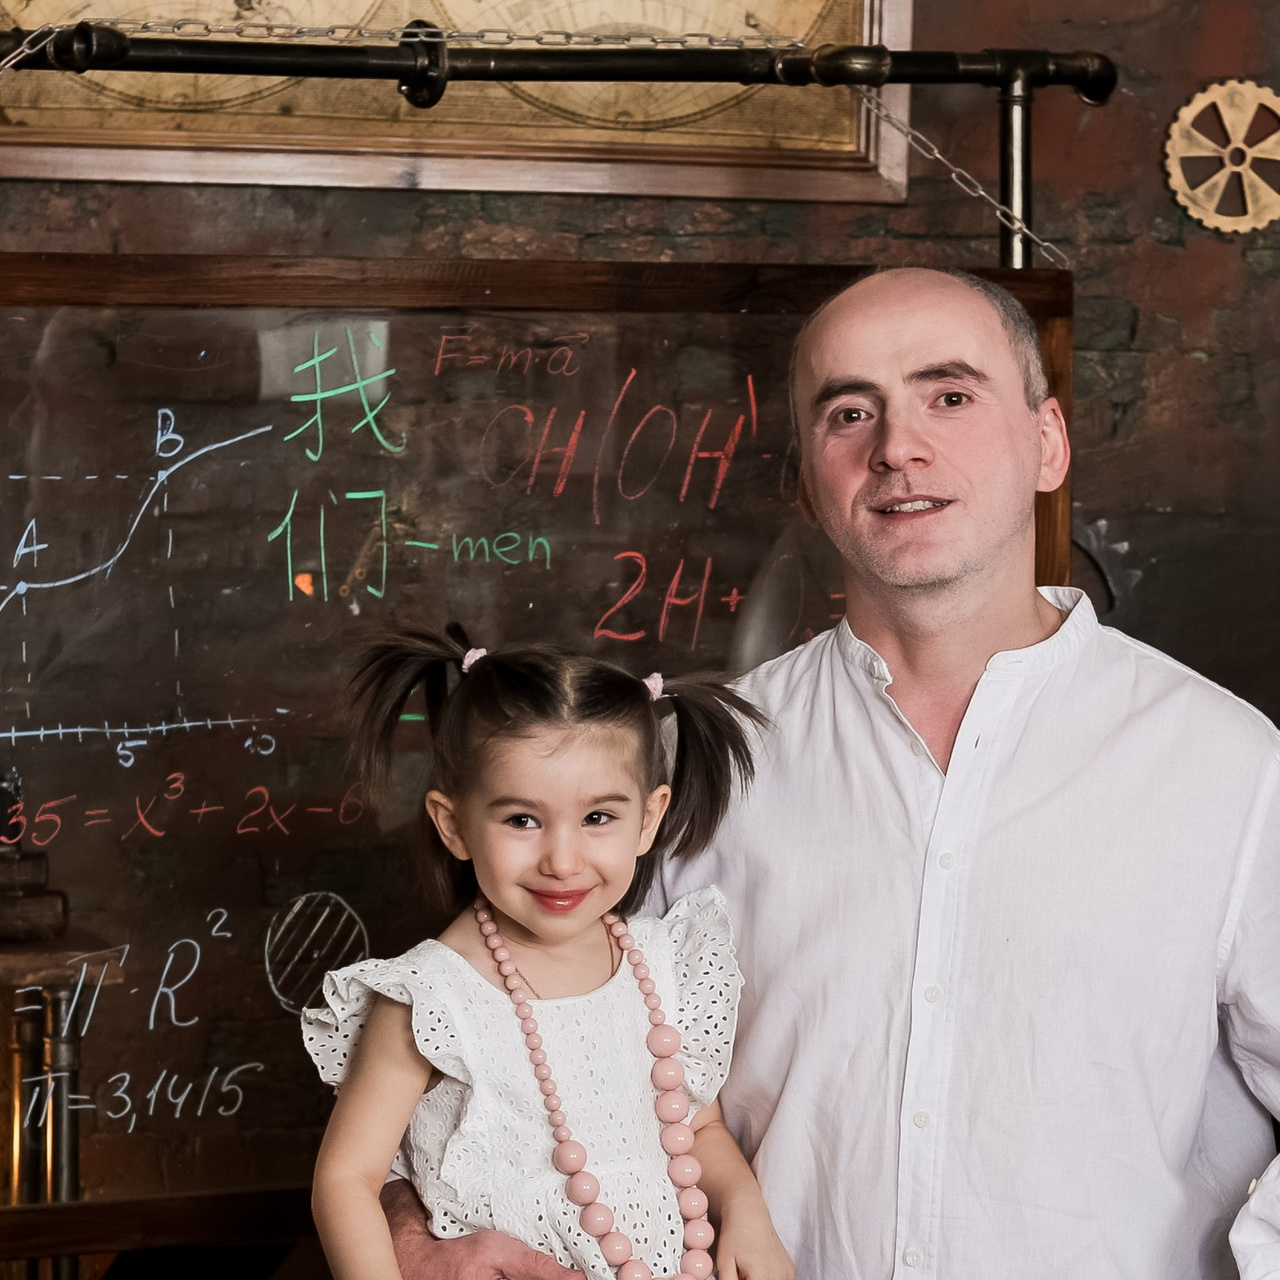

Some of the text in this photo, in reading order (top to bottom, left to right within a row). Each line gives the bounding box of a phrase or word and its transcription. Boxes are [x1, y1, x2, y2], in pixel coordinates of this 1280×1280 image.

[154, 407, 185, 457] B
[12, 518, 49, 568] A
[116, 739, 148, 768] 5
